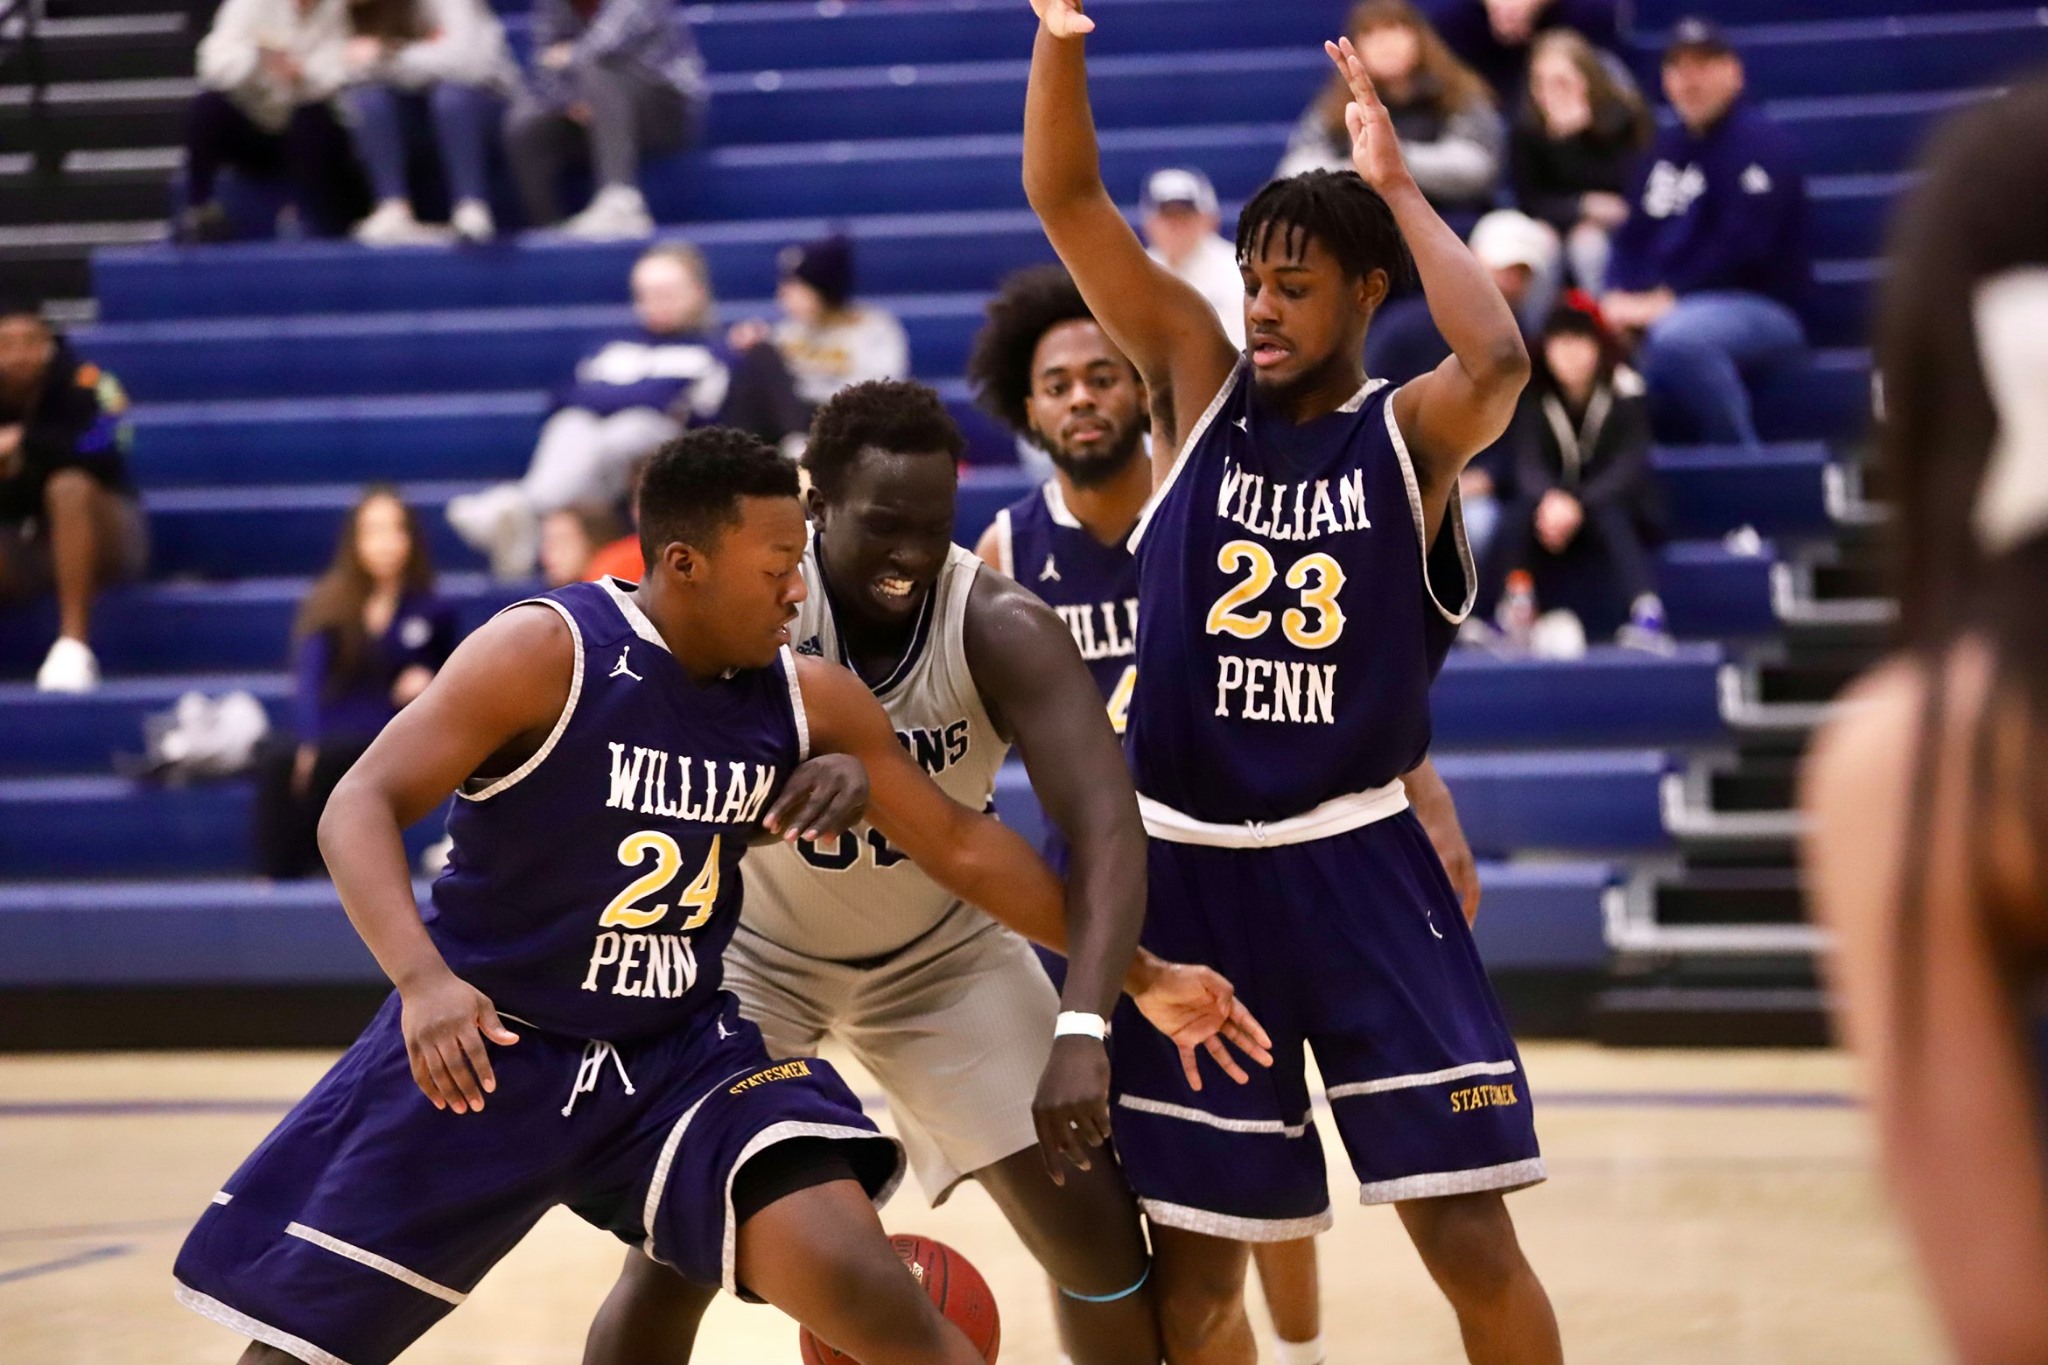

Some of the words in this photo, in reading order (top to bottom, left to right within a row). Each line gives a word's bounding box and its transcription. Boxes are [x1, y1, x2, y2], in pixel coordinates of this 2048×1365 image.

[1217, 455, 1372, 541] WILLIAM
[1205, 540, 1347, 650] 23
[1215, 655, 1337, 724] PENN
[605, 741, 776, 824] WILLIAM
[598, 830, 721, 931] 24
[581, 931, 698, 999] PENN
[729, 1060, 813, 1095] STATESMEN
